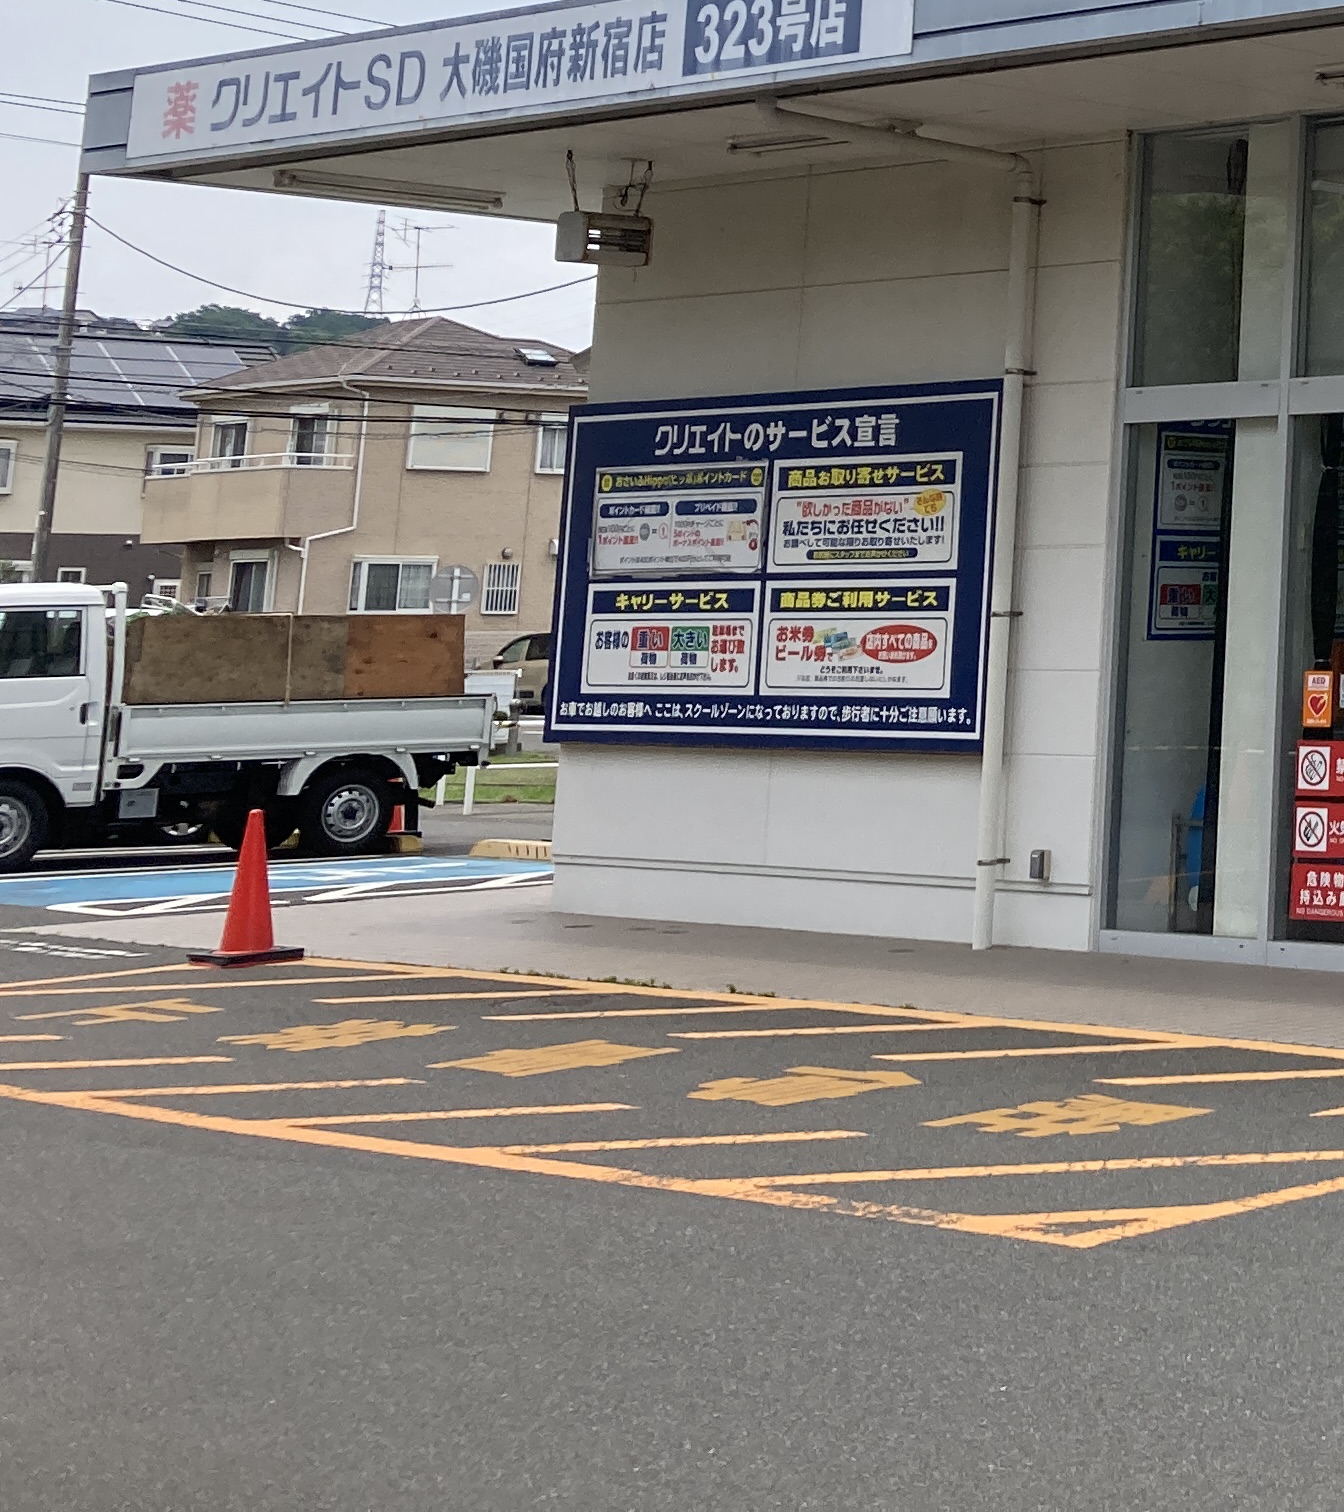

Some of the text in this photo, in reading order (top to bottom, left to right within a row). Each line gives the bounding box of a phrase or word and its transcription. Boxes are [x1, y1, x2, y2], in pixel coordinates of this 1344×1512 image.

[162, 80, 199, 139] 薬
[439, 10, 668, 102] 大磯国府新宿店
[654, 413, 900, 456] クリエイトのサービス宣言
[787, 463, 945, 487] 商品お取り寄せサービス
[782, 516, 944, 536] 私たちにお任せください!!
[616, 592, 729, 610] キャリーサービス
[780, 590, 938, 608] 商品券ご利用サービス
[637, 630, 663, 649] 重い
[672, 630, 708, 649] 大きい
